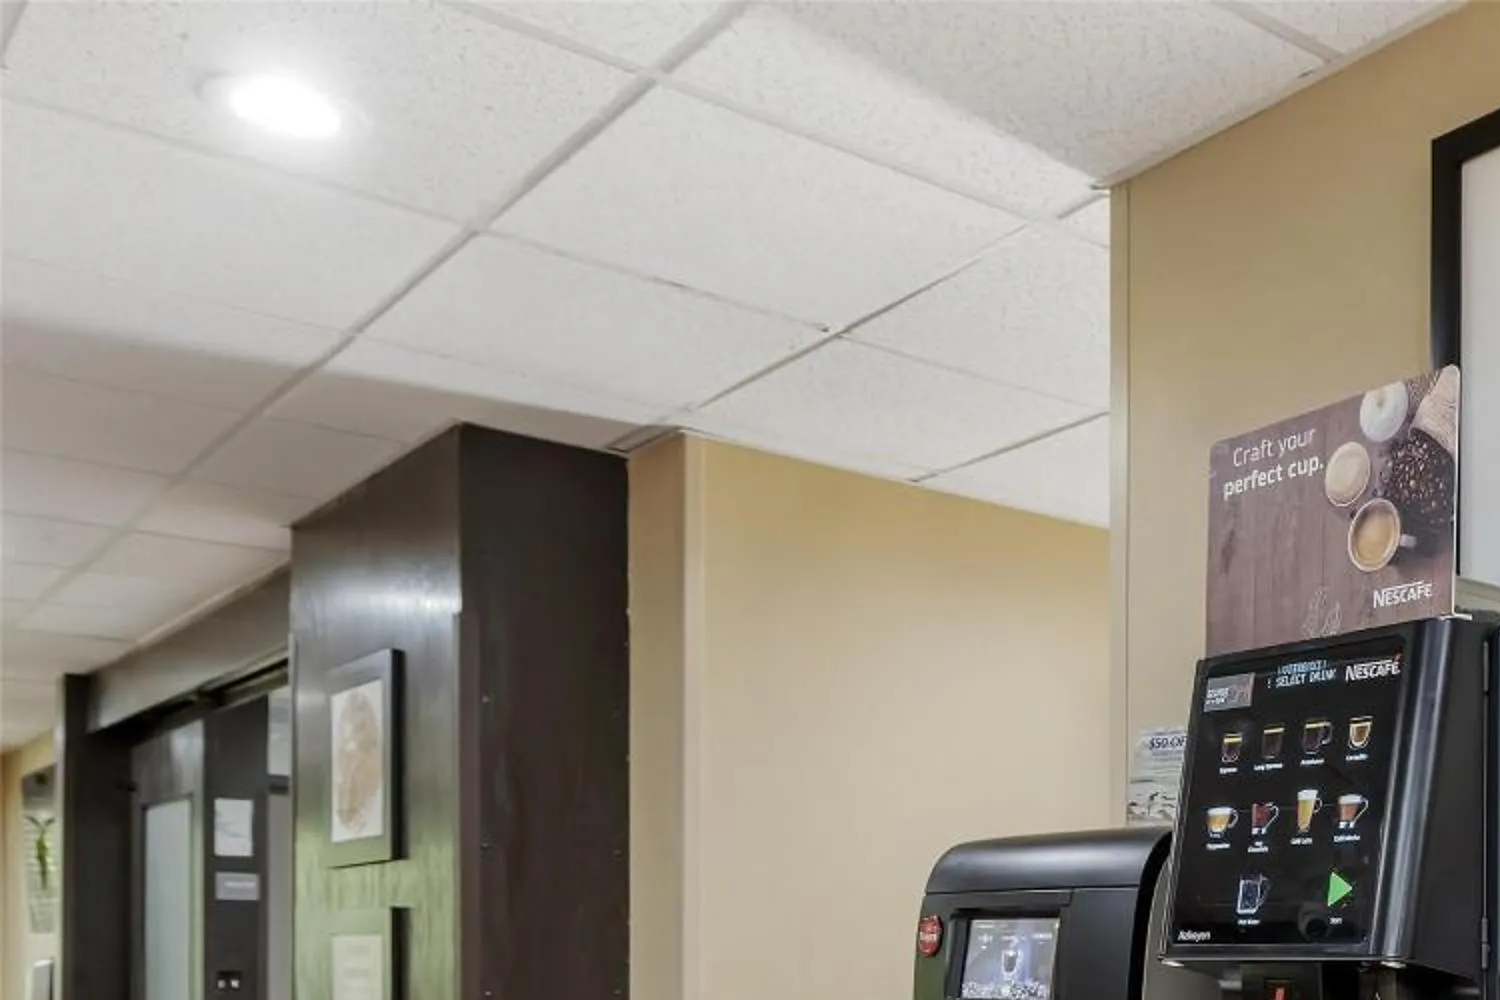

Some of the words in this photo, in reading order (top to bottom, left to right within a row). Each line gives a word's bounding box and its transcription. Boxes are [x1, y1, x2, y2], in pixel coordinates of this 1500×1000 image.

[1232, 439, 1274, 467] Craft
[1277, 428, 1317, 459] your
[1222, 467, 1283, 500] perfect
[1287, 454, 1325, 481] cup.
